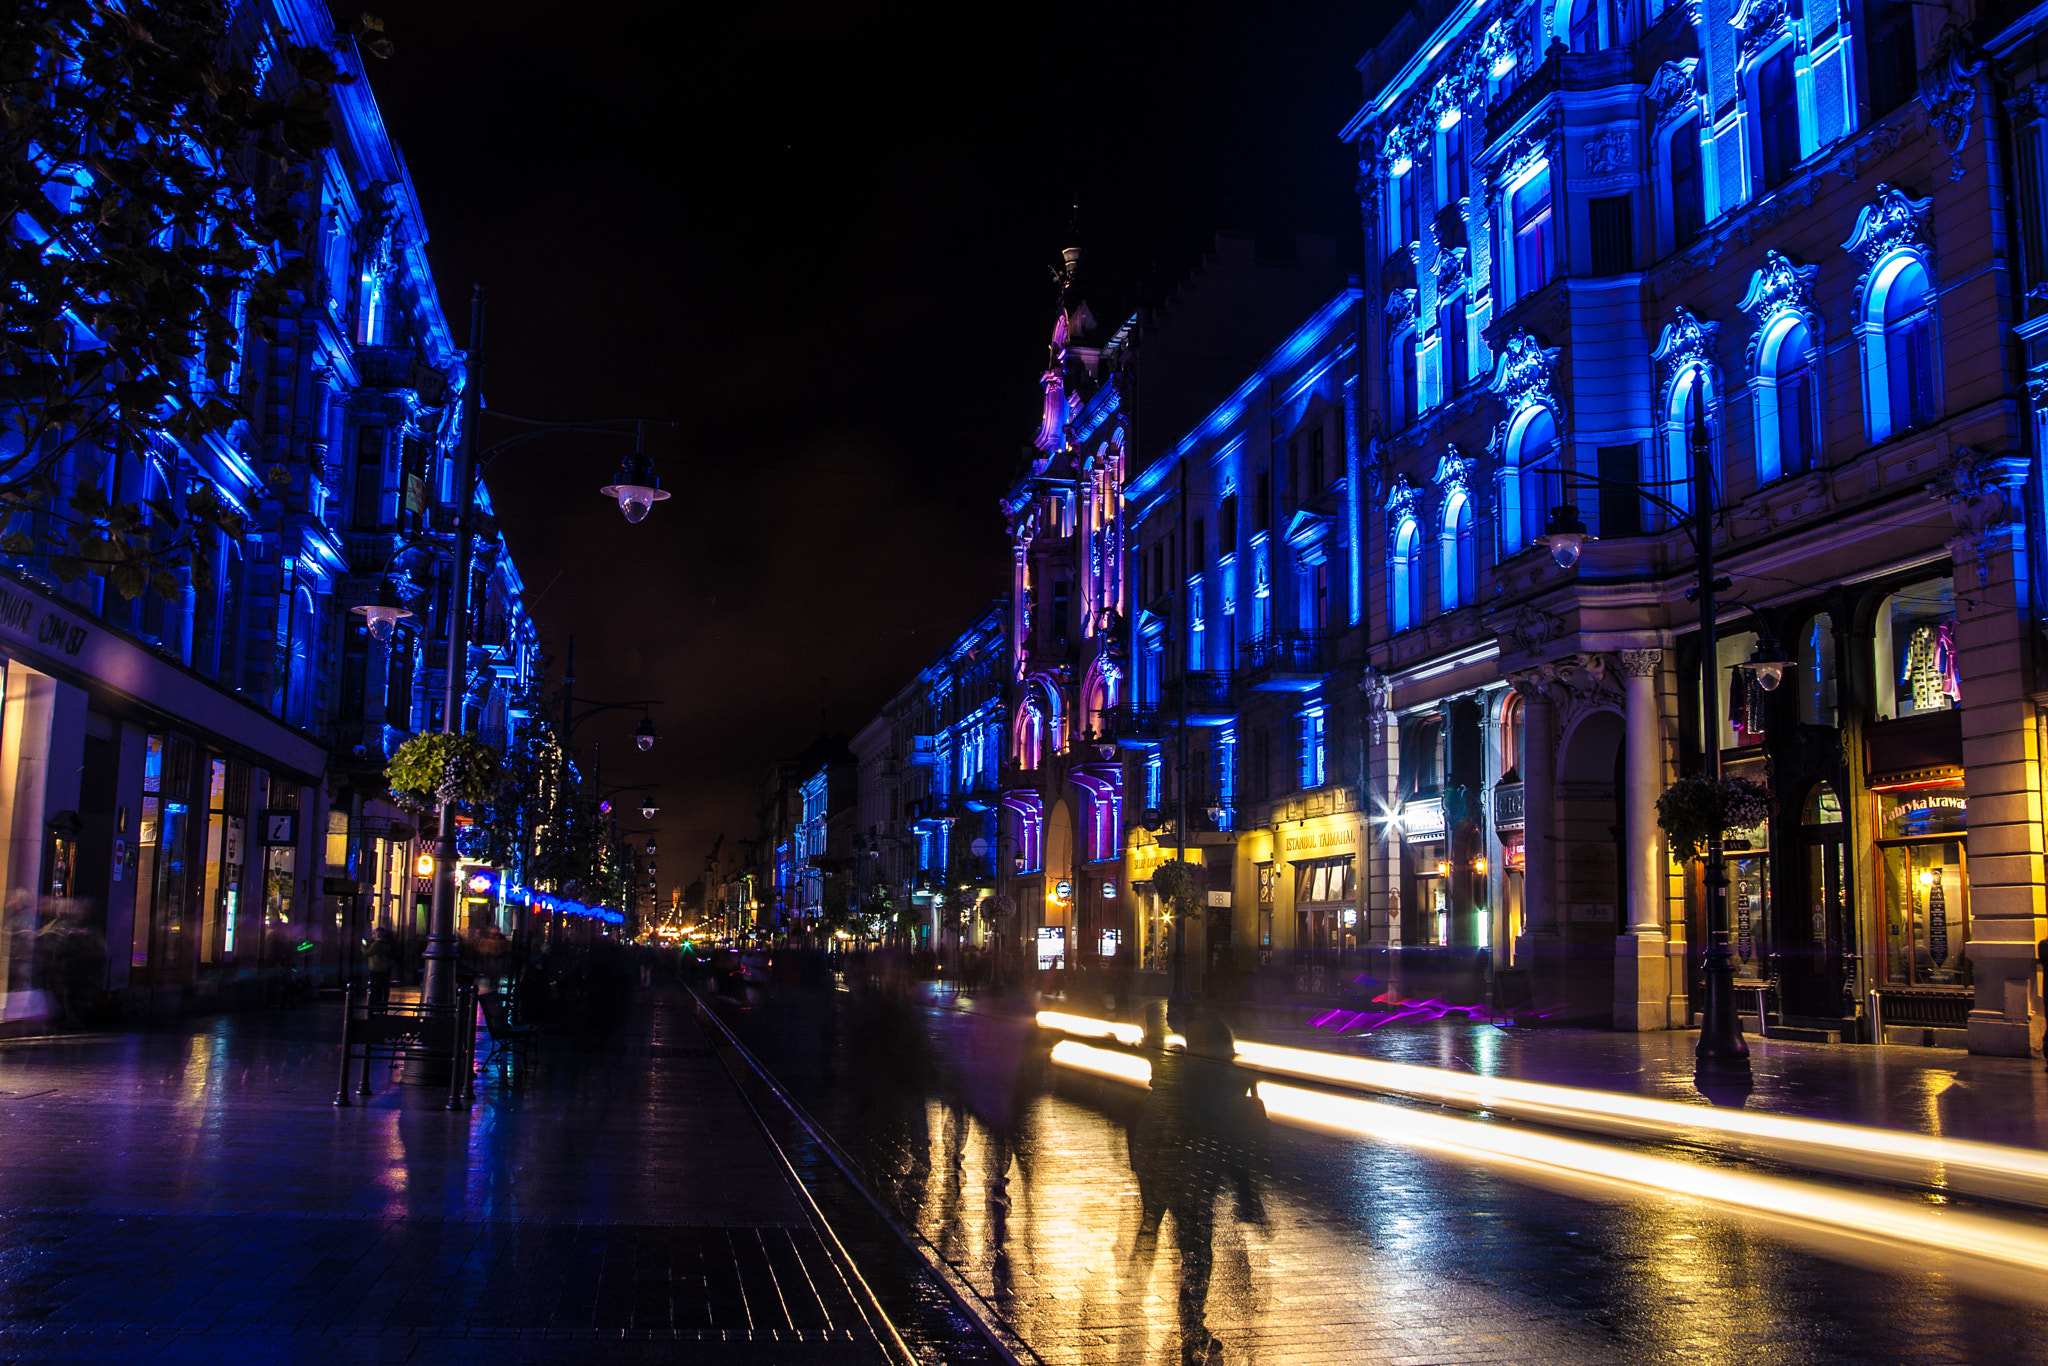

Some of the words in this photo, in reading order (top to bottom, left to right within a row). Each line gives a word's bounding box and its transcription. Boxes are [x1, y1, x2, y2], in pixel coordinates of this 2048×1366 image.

[1500, 795, 1524, 814] CIG
[1928, 796, 1967, 810] krawa
[1286, 834, 1317, 852] ISTANBUL
[1729, 842, 1747, 850] WC
